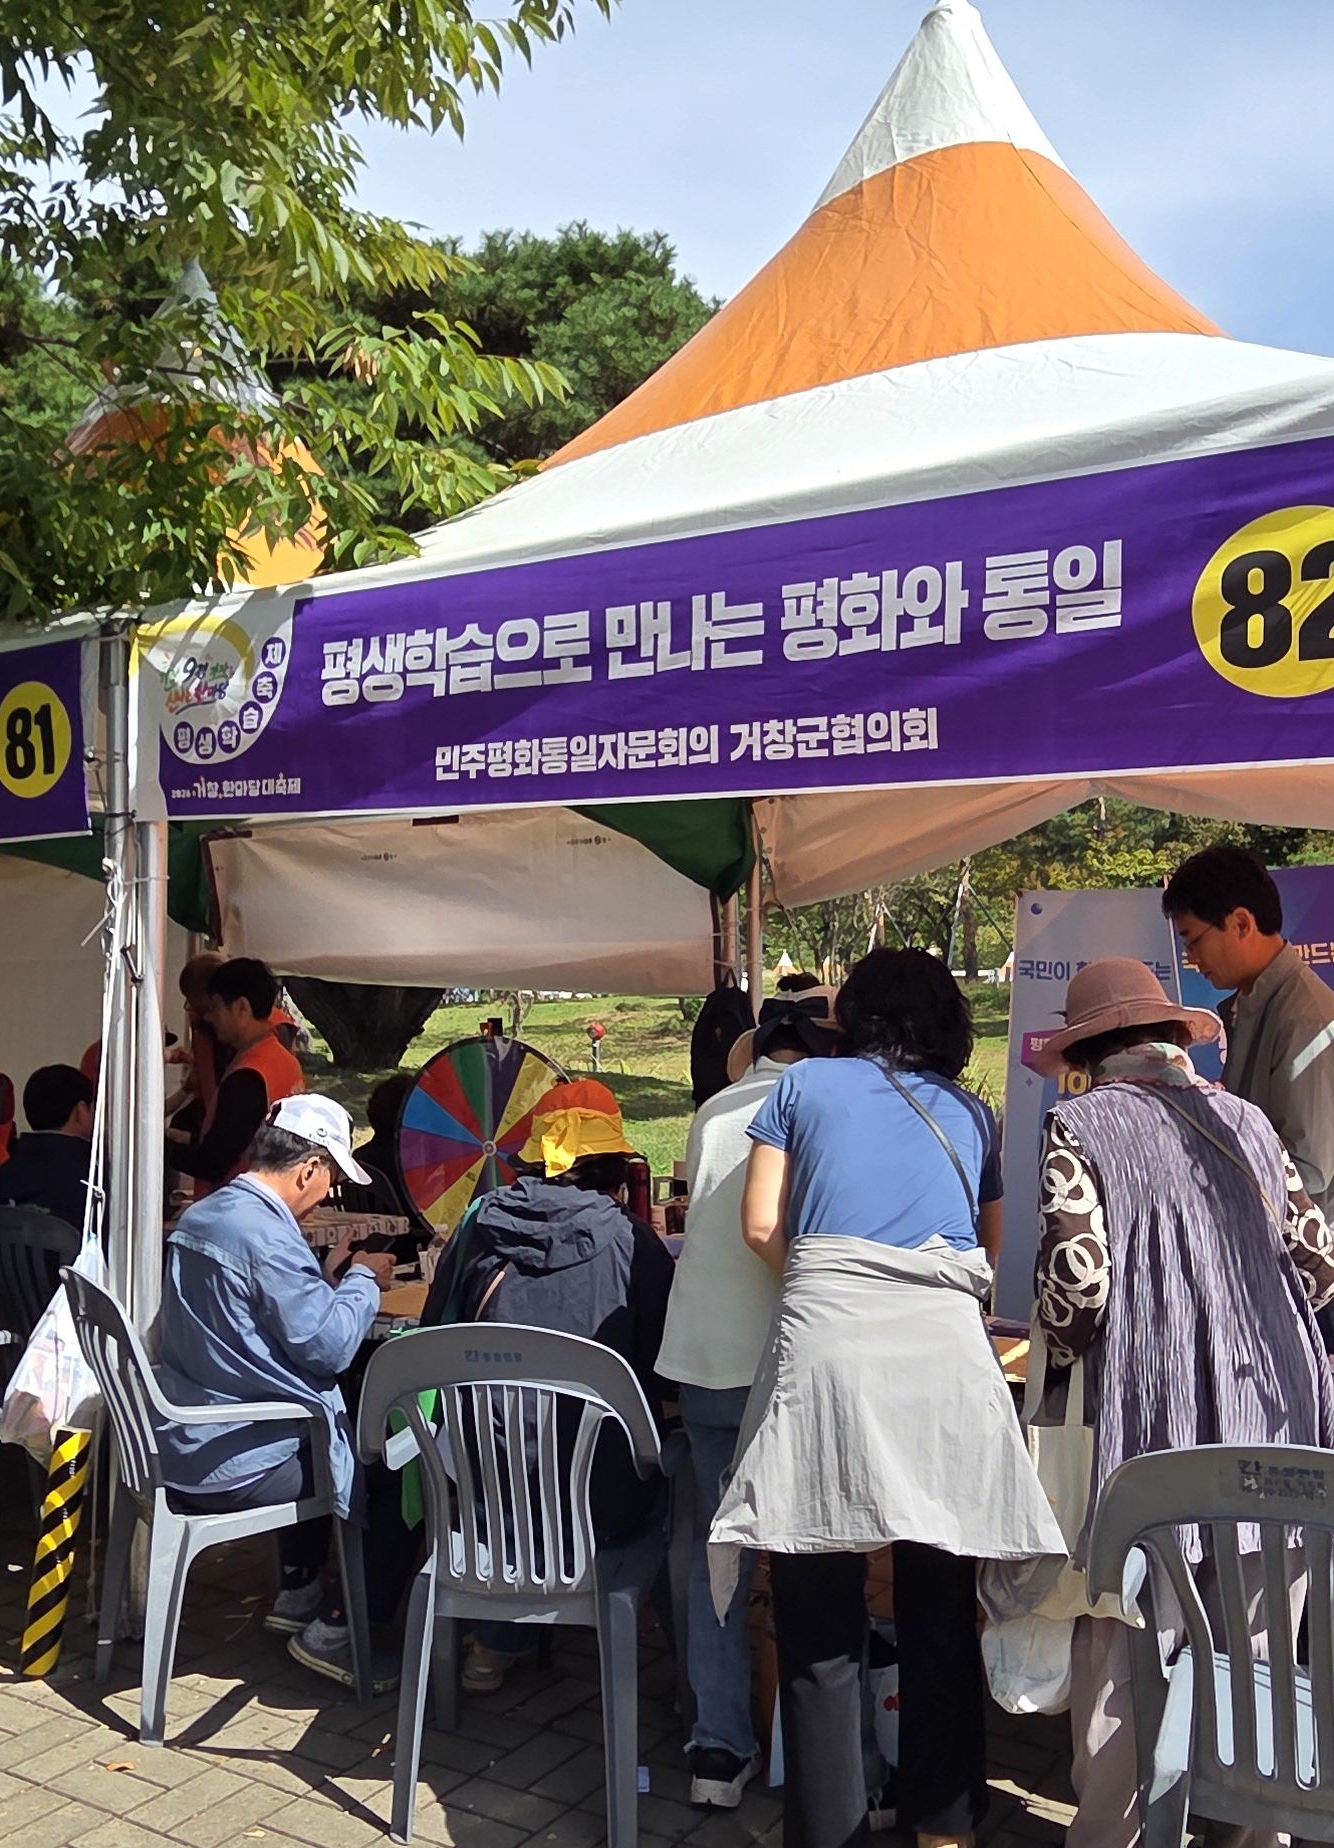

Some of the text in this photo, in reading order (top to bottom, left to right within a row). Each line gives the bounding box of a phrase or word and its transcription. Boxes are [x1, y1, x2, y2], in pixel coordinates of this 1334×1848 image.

[321, 539, 1123, 706] 평생학습으로 만나는 평화와 통일
[5, 703, 55, 779] 81
[435, 707, 939, 781] 민주평화통일자문회의 거창군협의회
[1019, 960, 1071, 981] 국민이
